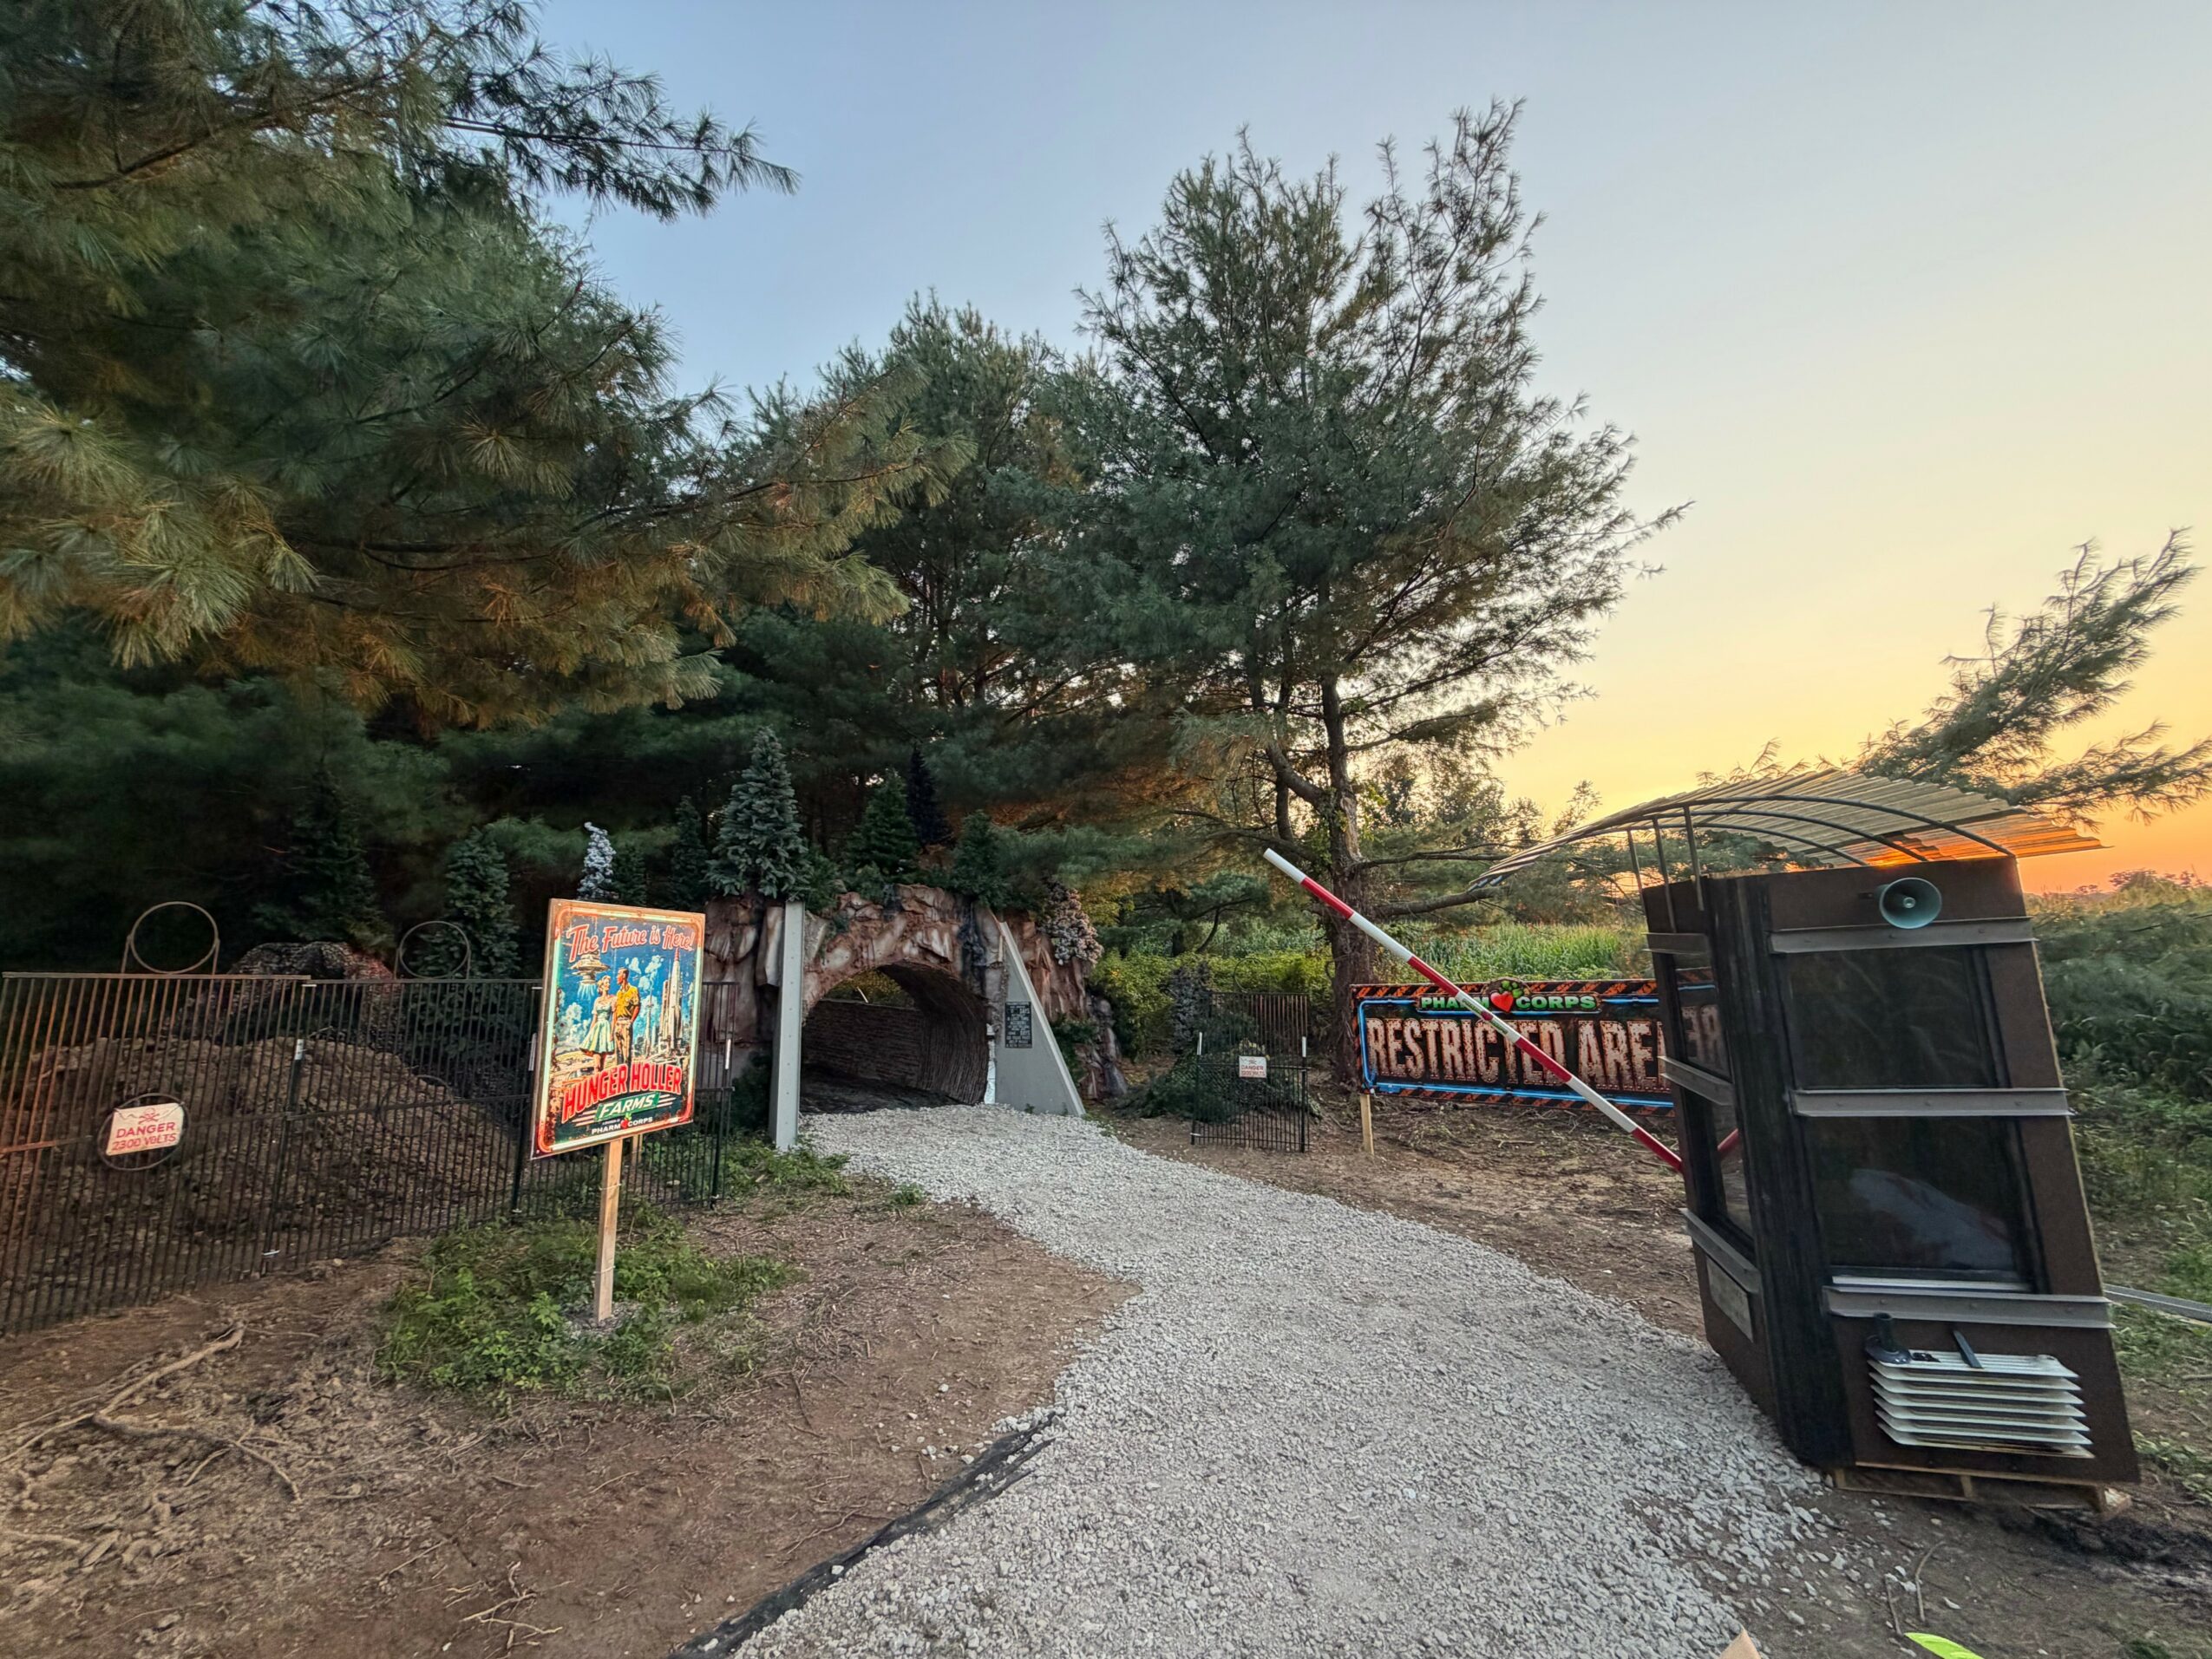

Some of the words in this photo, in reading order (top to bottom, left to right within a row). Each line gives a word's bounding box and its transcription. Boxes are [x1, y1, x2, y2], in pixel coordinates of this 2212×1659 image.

[566, 924, 599, 963] The
[601, 925, 647, 953] Future
[650, 924, 661, 944] is
[663, 924, 695, 951] Here!
[1422, 996, 1489, 1009] PHAM
[1515, 996, 1596, 1009] CORPS
[1365, 1018, 1567, 1087] RESTRICTED
[561, 1063, 628, 1124] HUNGER
[629, 1061, 683, 1095] HOLLER
[599, 1094, 655, 1119] FARMS
[116, 1122, 175, 1138] DANGER
[592, 1124, 621, 1135] PHARM
[627, 1116, 653, 1127] CORPS
[111, 1138, 141, 1151] 2300
[144, 1133, 177, 1146] VOLTS
